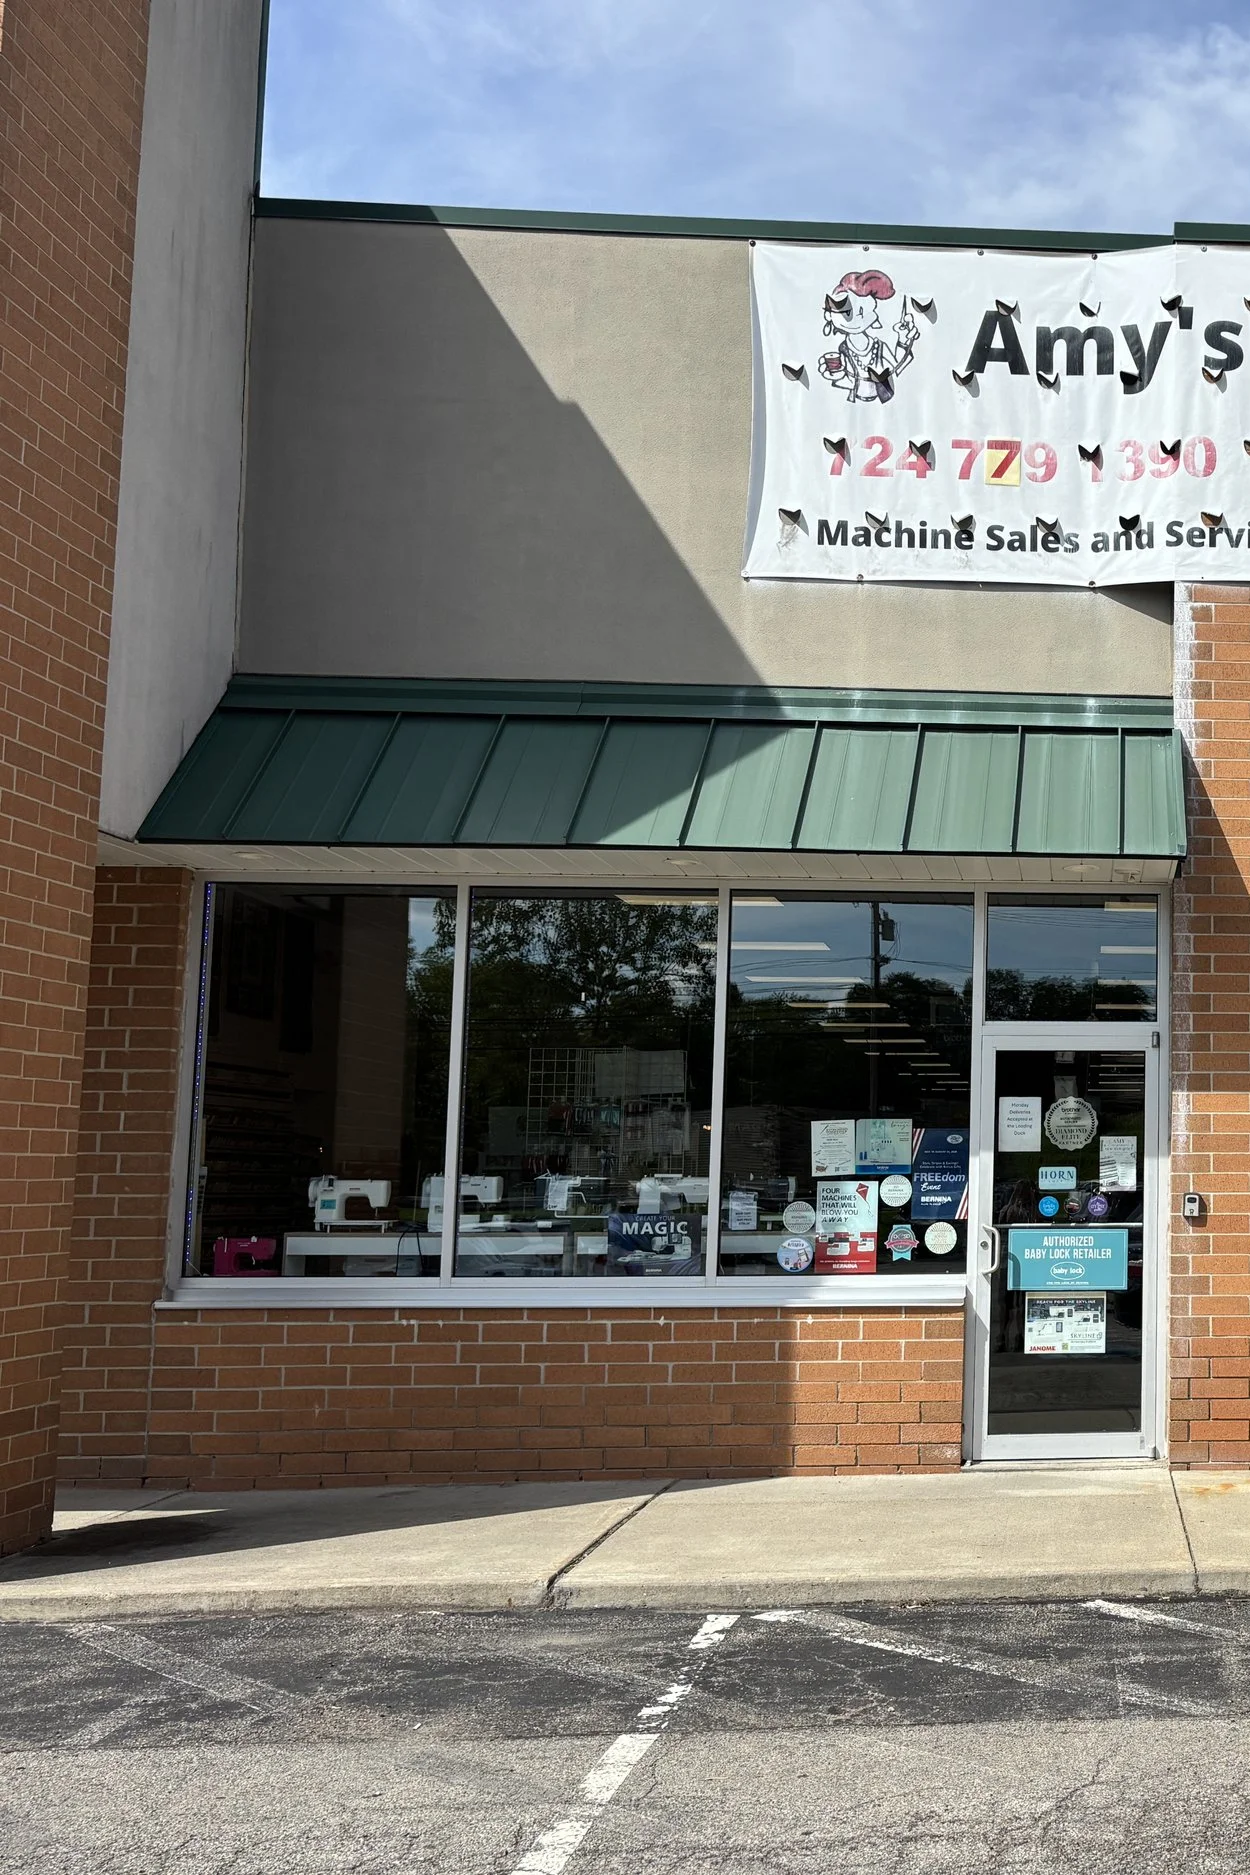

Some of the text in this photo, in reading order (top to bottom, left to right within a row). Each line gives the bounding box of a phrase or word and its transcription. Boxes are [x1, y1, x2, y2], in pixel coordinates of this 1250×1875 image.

[965, 306, 1244, 395] Amy's
[951, 439, 1058, 483] 779
[817, 519, 974, 551] Machine
[986, 524, 1080, 553] Sales
[1091, 521, 1154, 553] and
[914, 1172, 966, 1182] FREEdom
[1040, 1171, 1073, 1180] HORN
[921, 1182, 942, 1191] Event
[622, 1221, 688, 1235] MAGIC
[1043, 1236, 1094, 1246] AUTHORIZED
[1024, 1248, 1112, 1259] BABY LOCK RETAILER
[1053, 1267, 1067, 1275] baby
